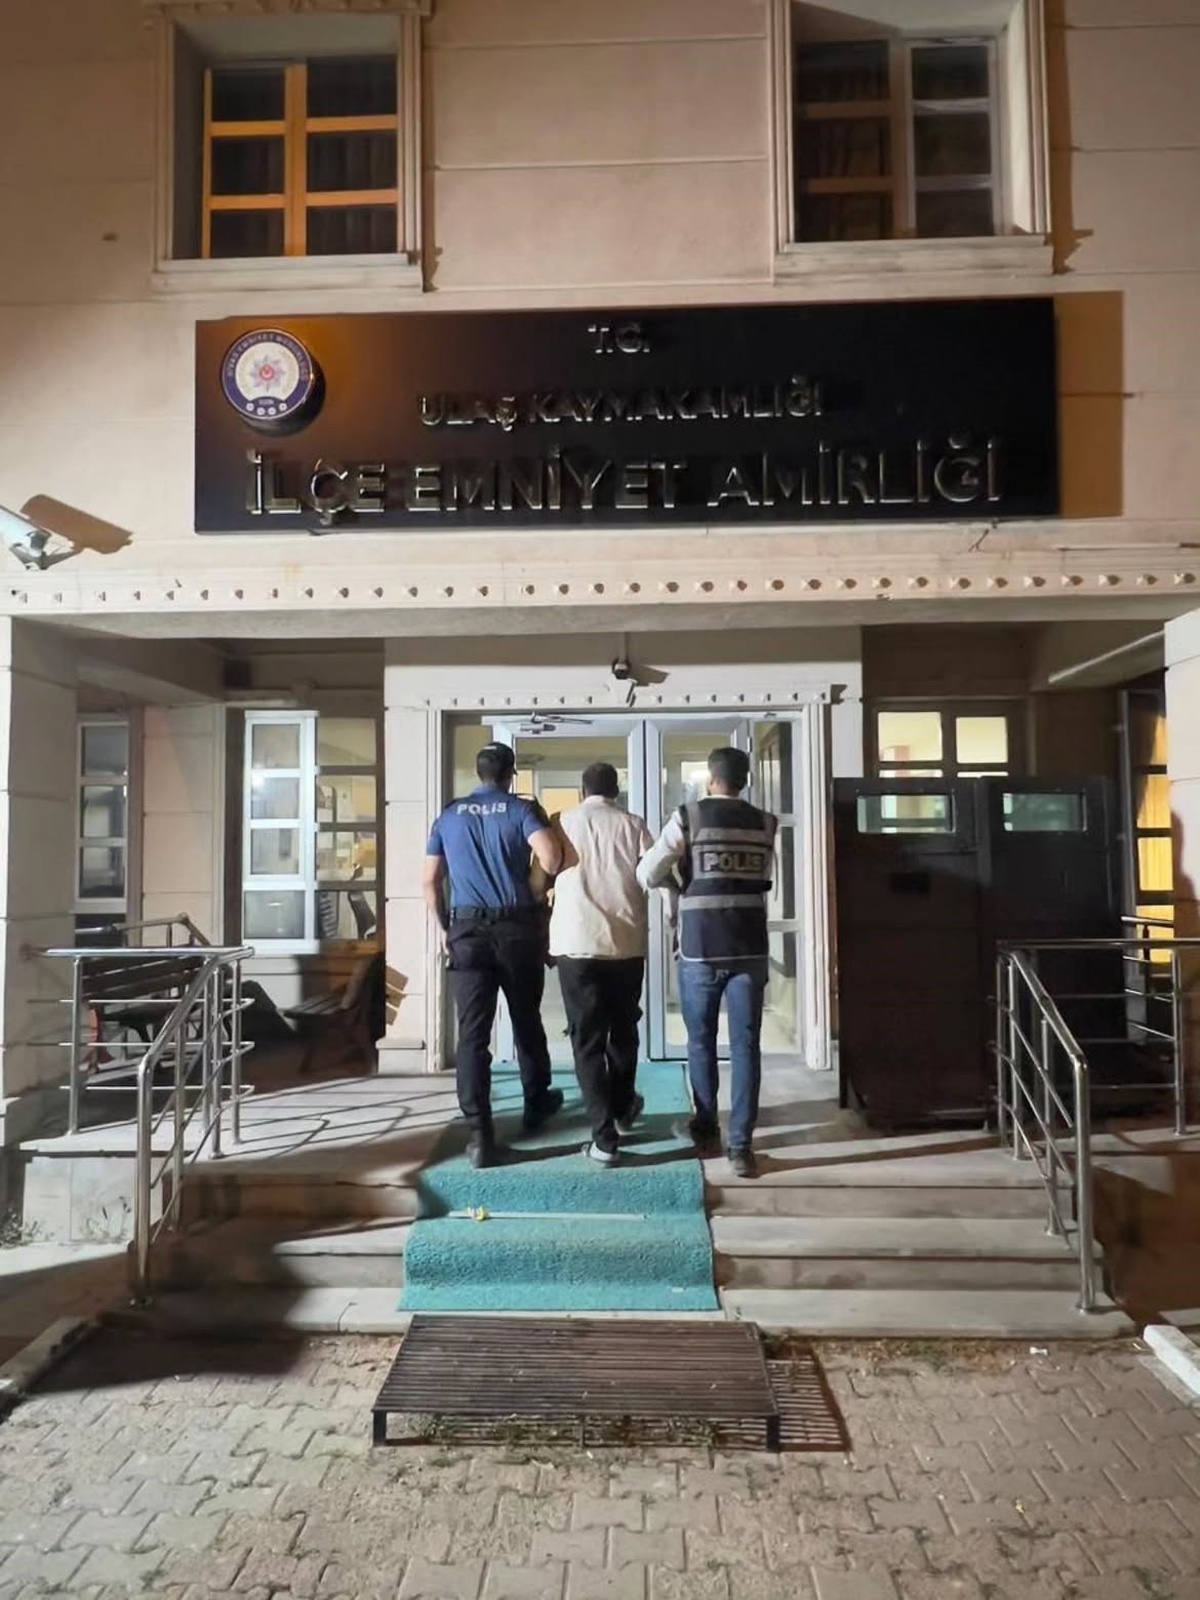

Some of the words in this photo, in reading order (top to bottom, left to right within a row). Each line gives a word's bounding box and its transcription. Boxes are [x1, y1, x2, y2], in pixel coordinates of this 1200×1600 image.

[420, 394, 520, 432] ULAŞ
[528, 376, 822, 423] KAYMAKAMLIĞI
[246, 448, 387, 526] İLÇE
[405, 445, 688, 511] EMNİYET
[706, 434, 1000, 505] AMİRLİĞİ
